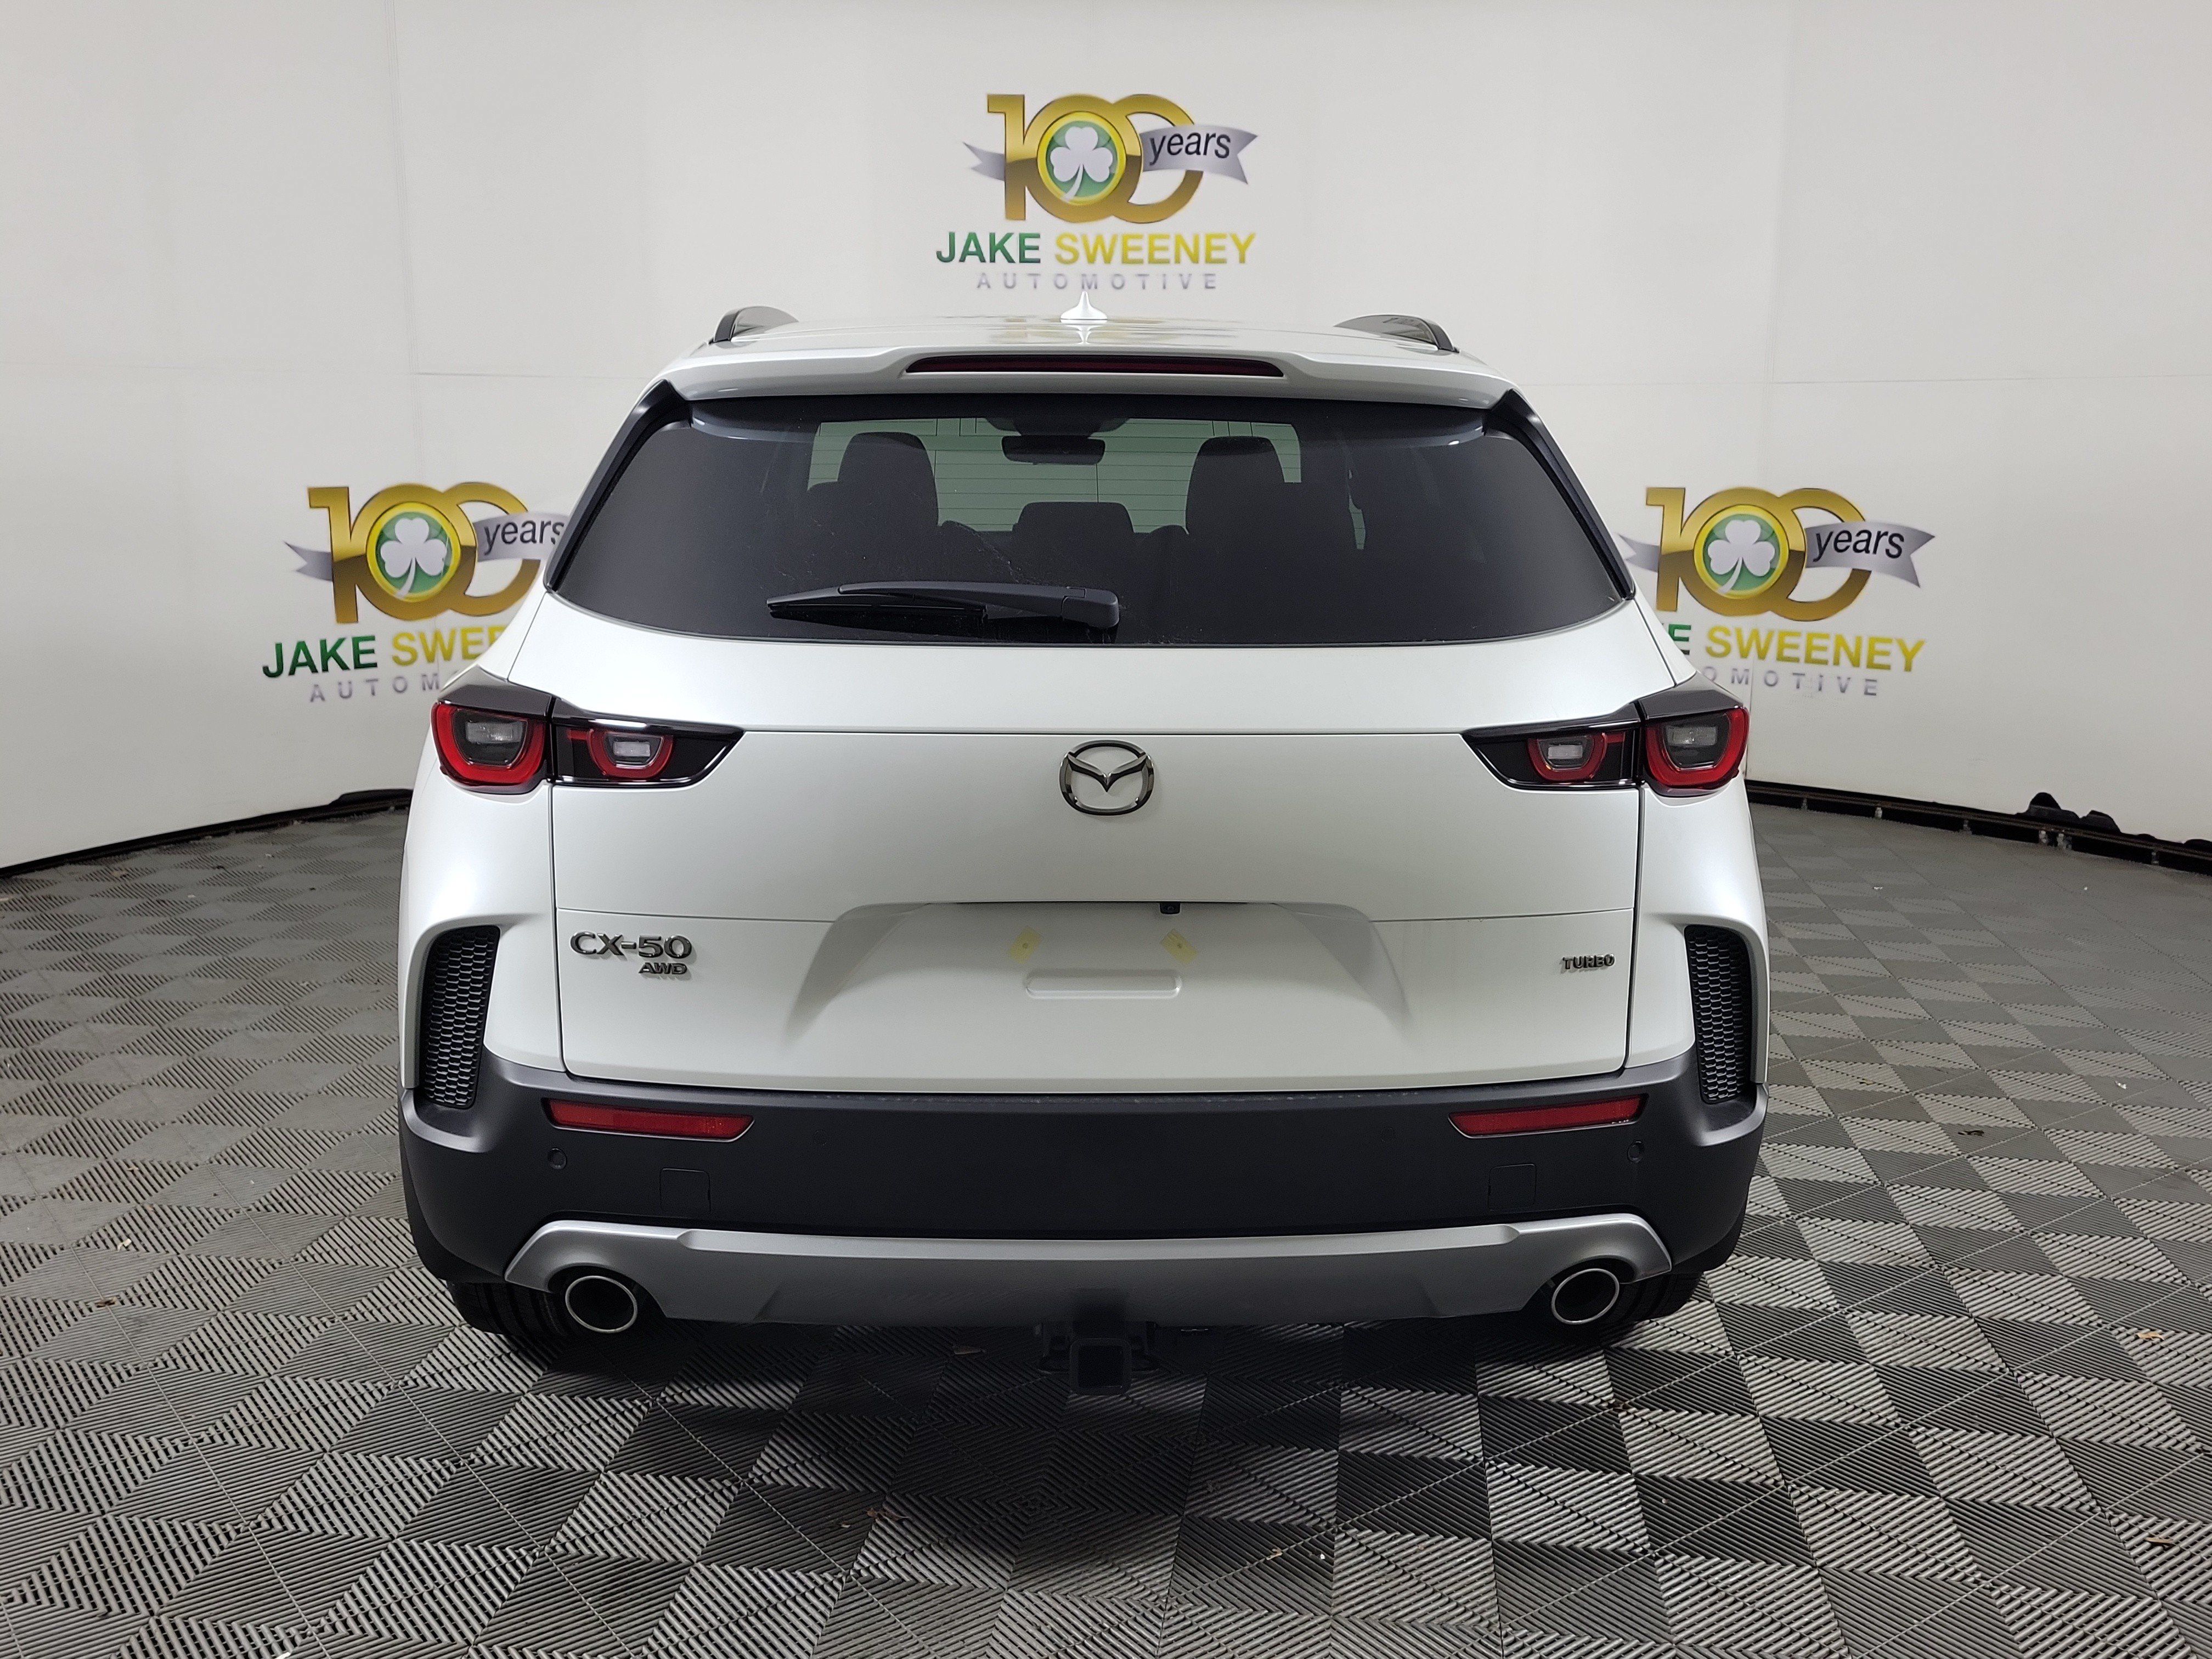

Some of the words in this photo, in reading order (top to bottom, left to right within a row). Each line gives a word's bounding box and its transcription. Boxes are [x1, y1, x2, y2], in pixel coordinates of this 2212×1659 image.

[1149, 132, 1231, 165] years
[936, 232, 1041, 264] JAKE
[1055, 233, 1257, 265] SWEENEY
[977, 273, 1217, 290] AUTOMOTIVE
[484, 520, 565, 555] years
[1813, 529, 1905, 562] years
[262, 635, 377, 678] JAKE
[1706, 625, 1926, 672] SWEENEY
[570, 931, 692, 959] CX-50
[1562, 953, 1615, 969] TURBO
[638, 962, 688, 975] AWD
